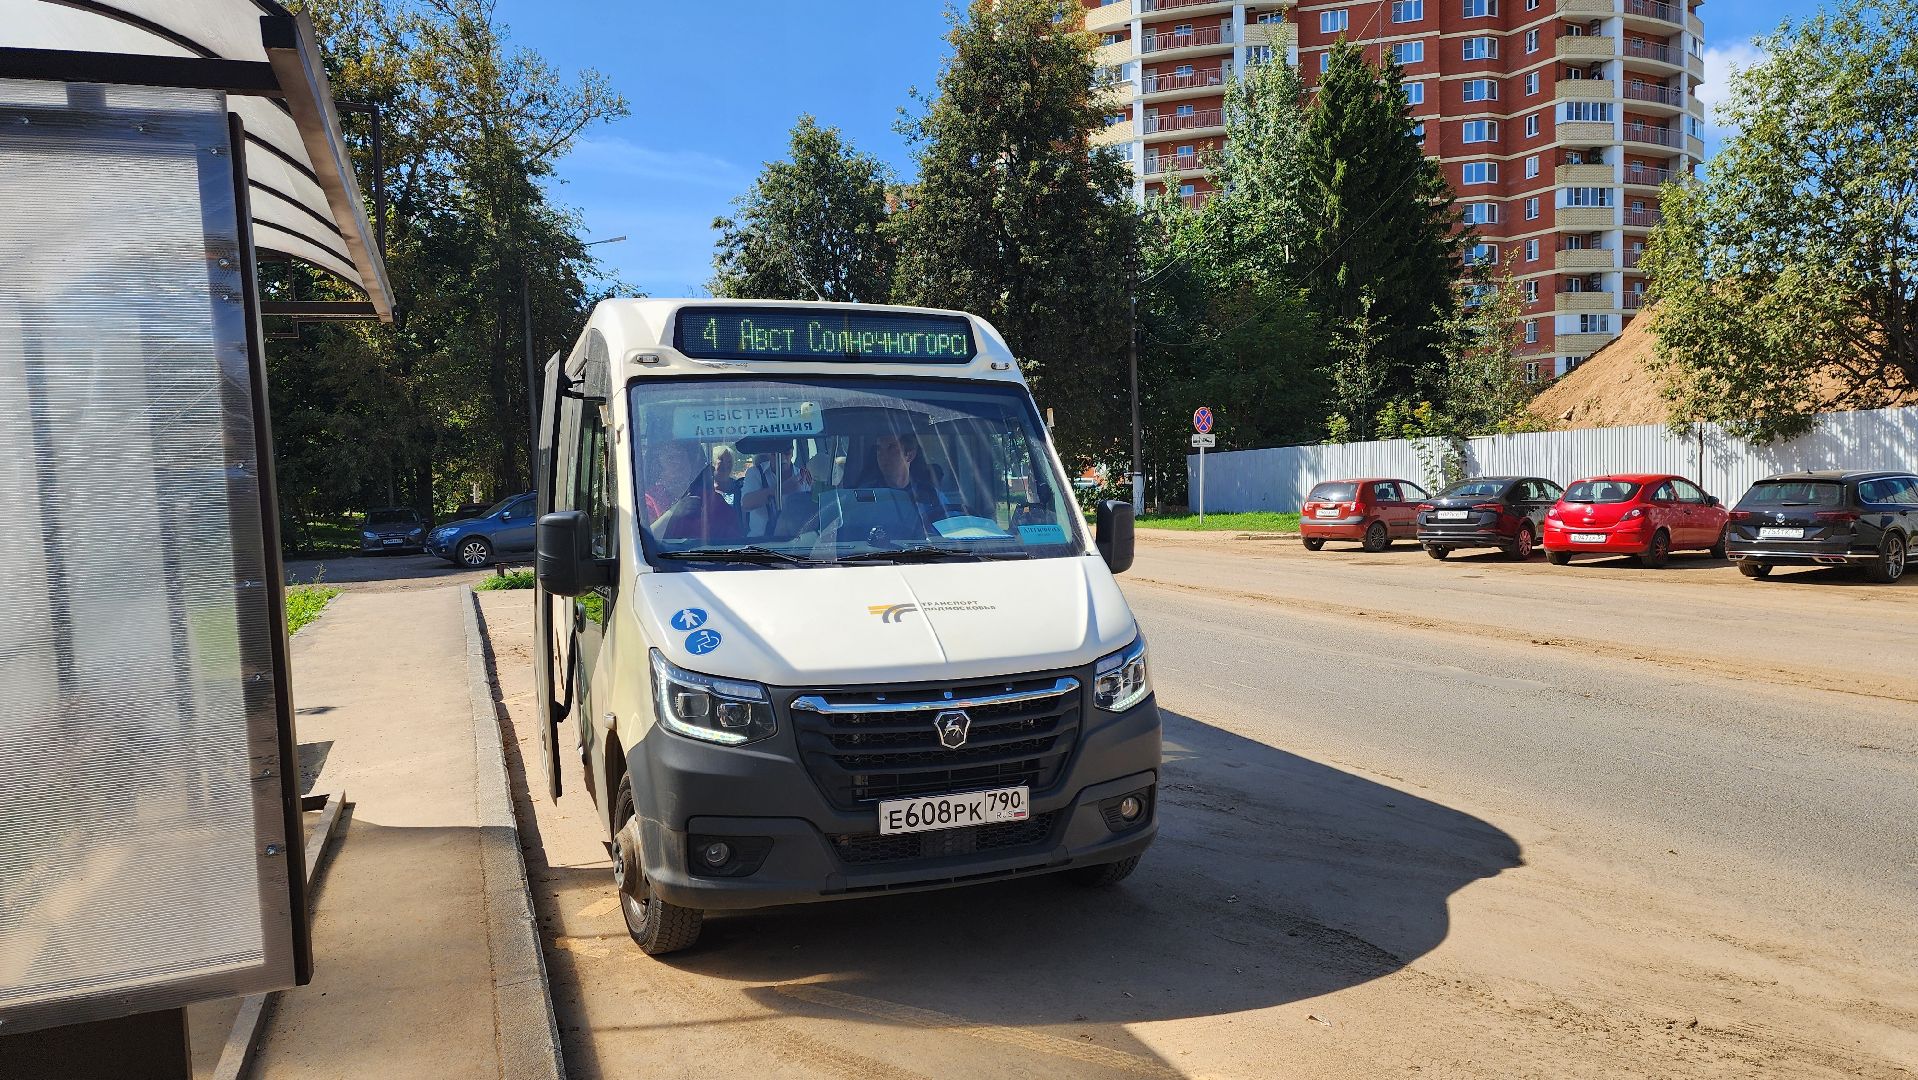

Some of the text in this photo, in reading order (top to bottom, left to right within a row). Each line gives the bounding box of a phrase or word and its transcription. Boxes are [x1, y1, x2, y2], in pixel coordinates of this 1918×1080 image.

[704, 318, 717, 349] 4
[740, 318, 794, 351] Авст
[889, 791, 1021, 829] Е608РК 790
